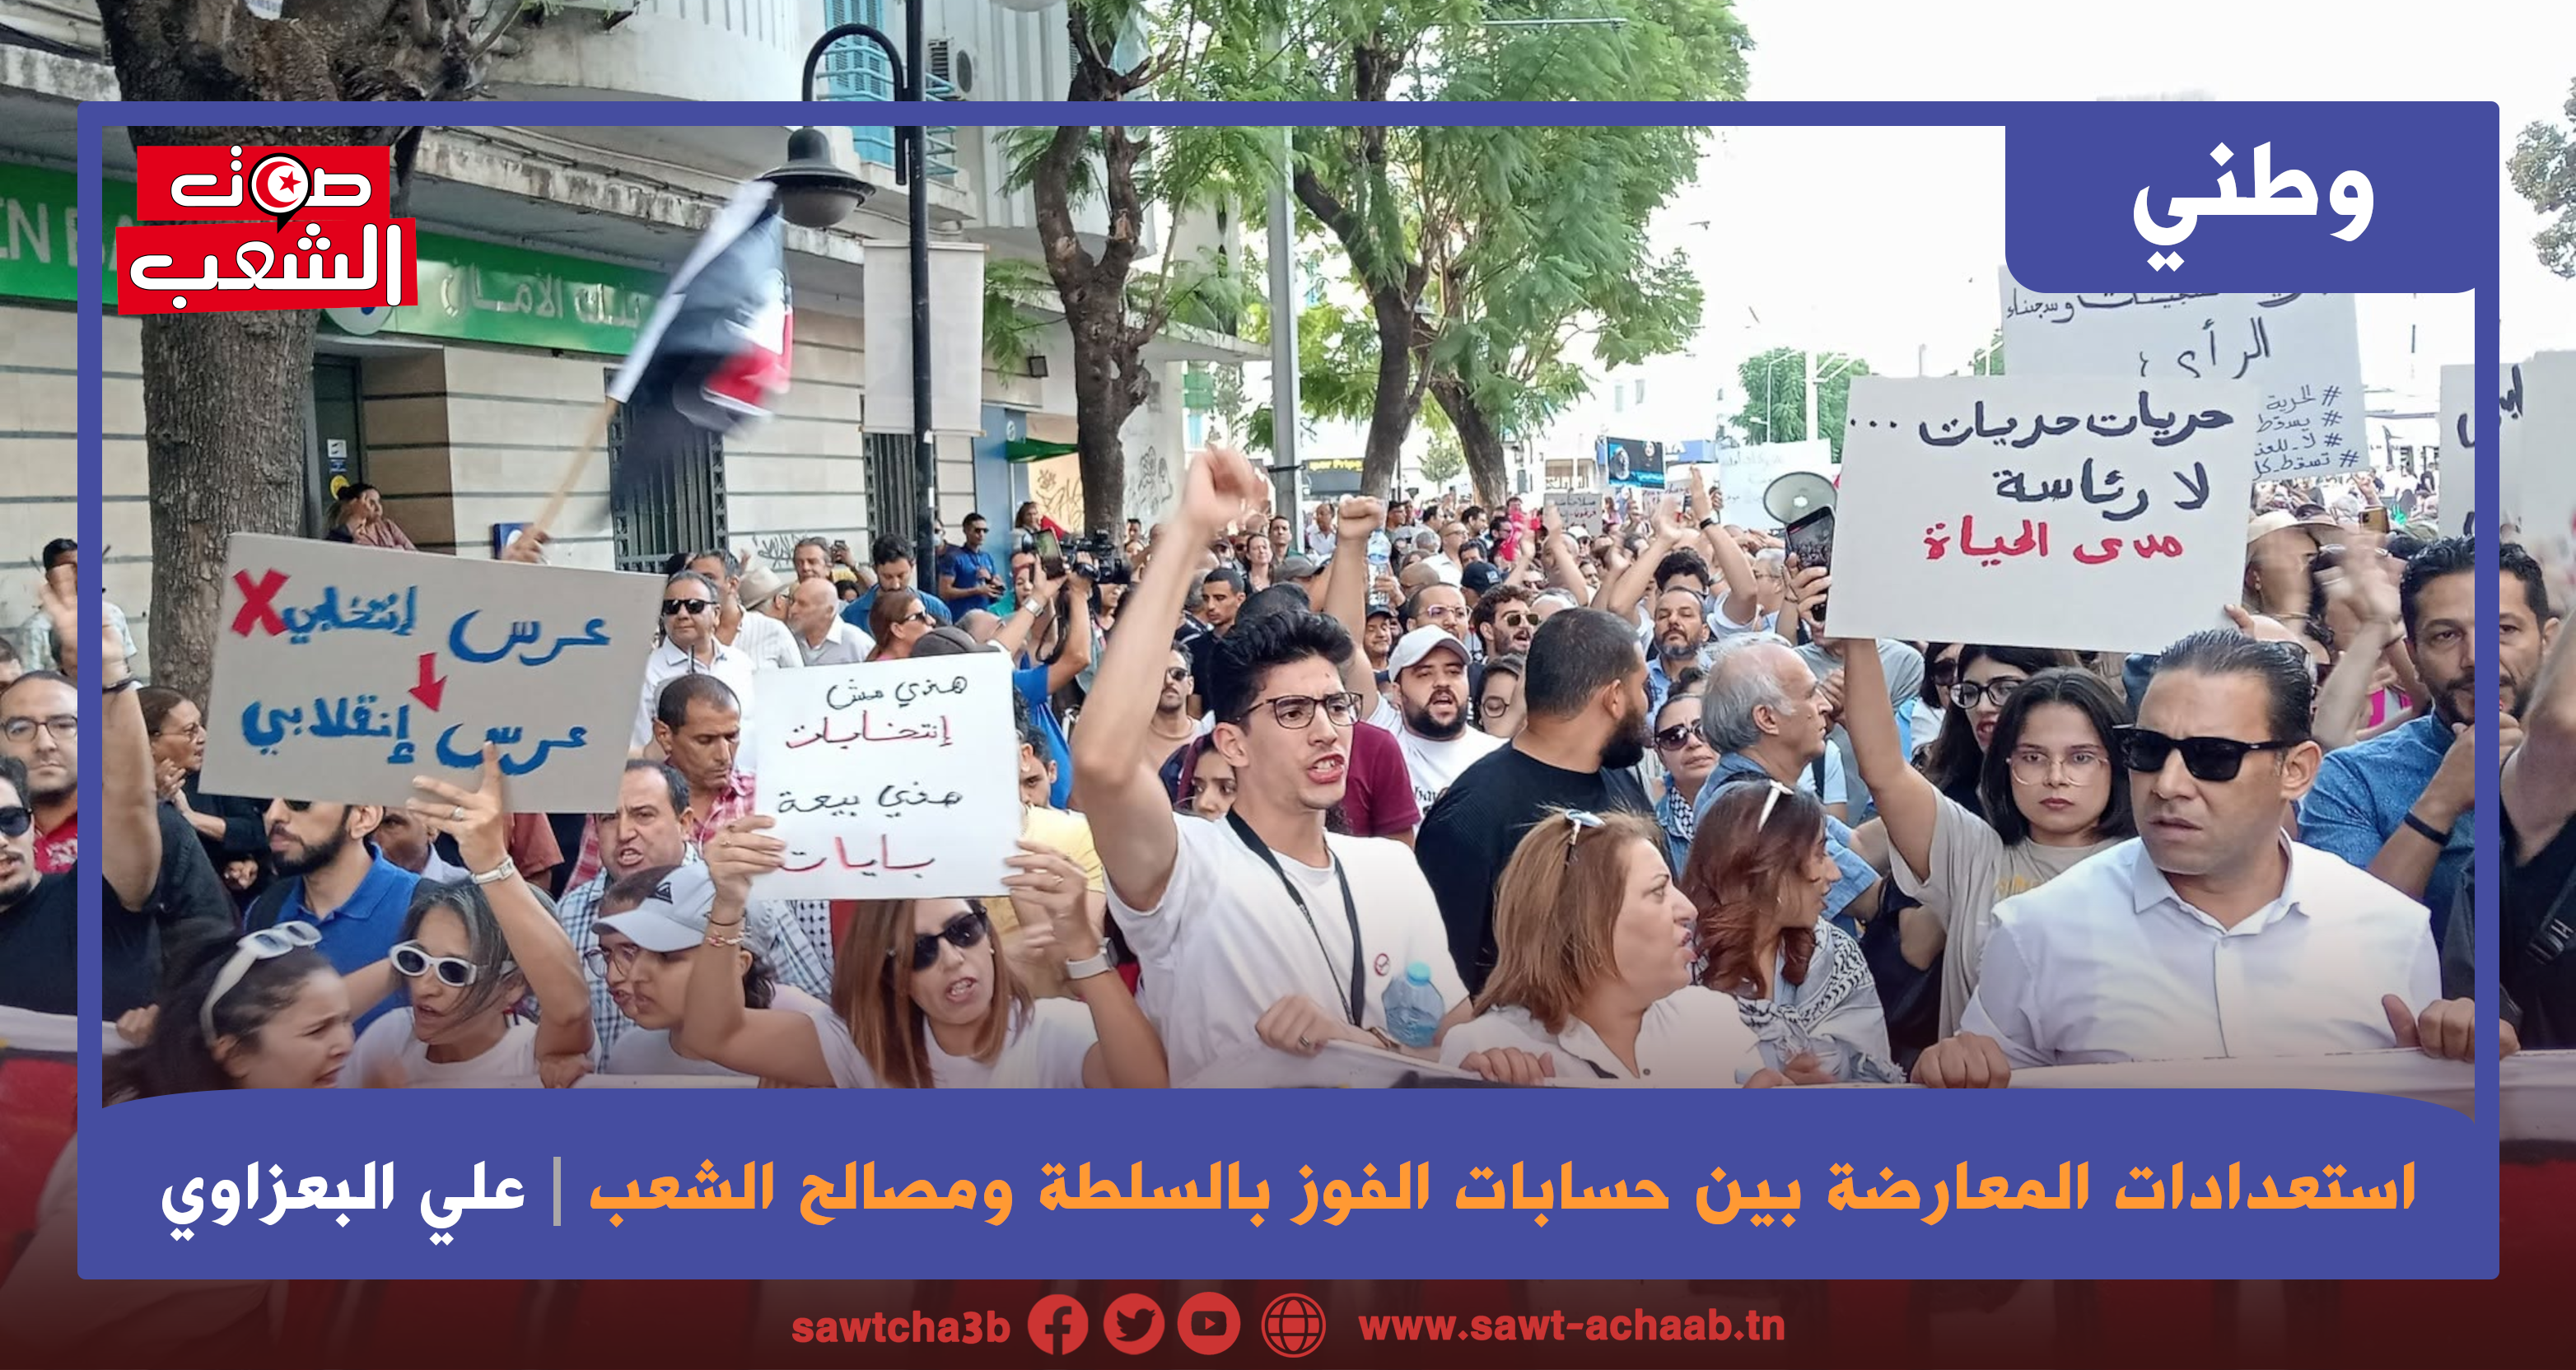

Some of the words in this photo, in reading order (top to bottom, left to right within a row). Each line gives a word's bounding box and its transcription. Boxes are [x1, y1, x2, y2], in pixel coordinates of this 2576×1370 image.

[1920, 401, 2080, 448] حريات
[2086, 390, 2234, 446] حريات
[1992, 457, 2149, 521] رئاسة
[2172, 461, 2210, 510] لا
[1924, 514, 2048, 567] الحياة
[2072, 532, 2183, 565] مدى
[449, 609, 611, 667] عرس
[826, 679, 884, 710] مش
[895, 676, 968, 708] هذي
[241, 694, 416, 765] إنقلابي
[436, 724, 587, 776] عرس
[786, 710, 953, 749] إنتخابات
[777, 791, 860, 817] بيعة
[878, 781, 964, 818] هذي
[779, 834, 936, 878] بايات
